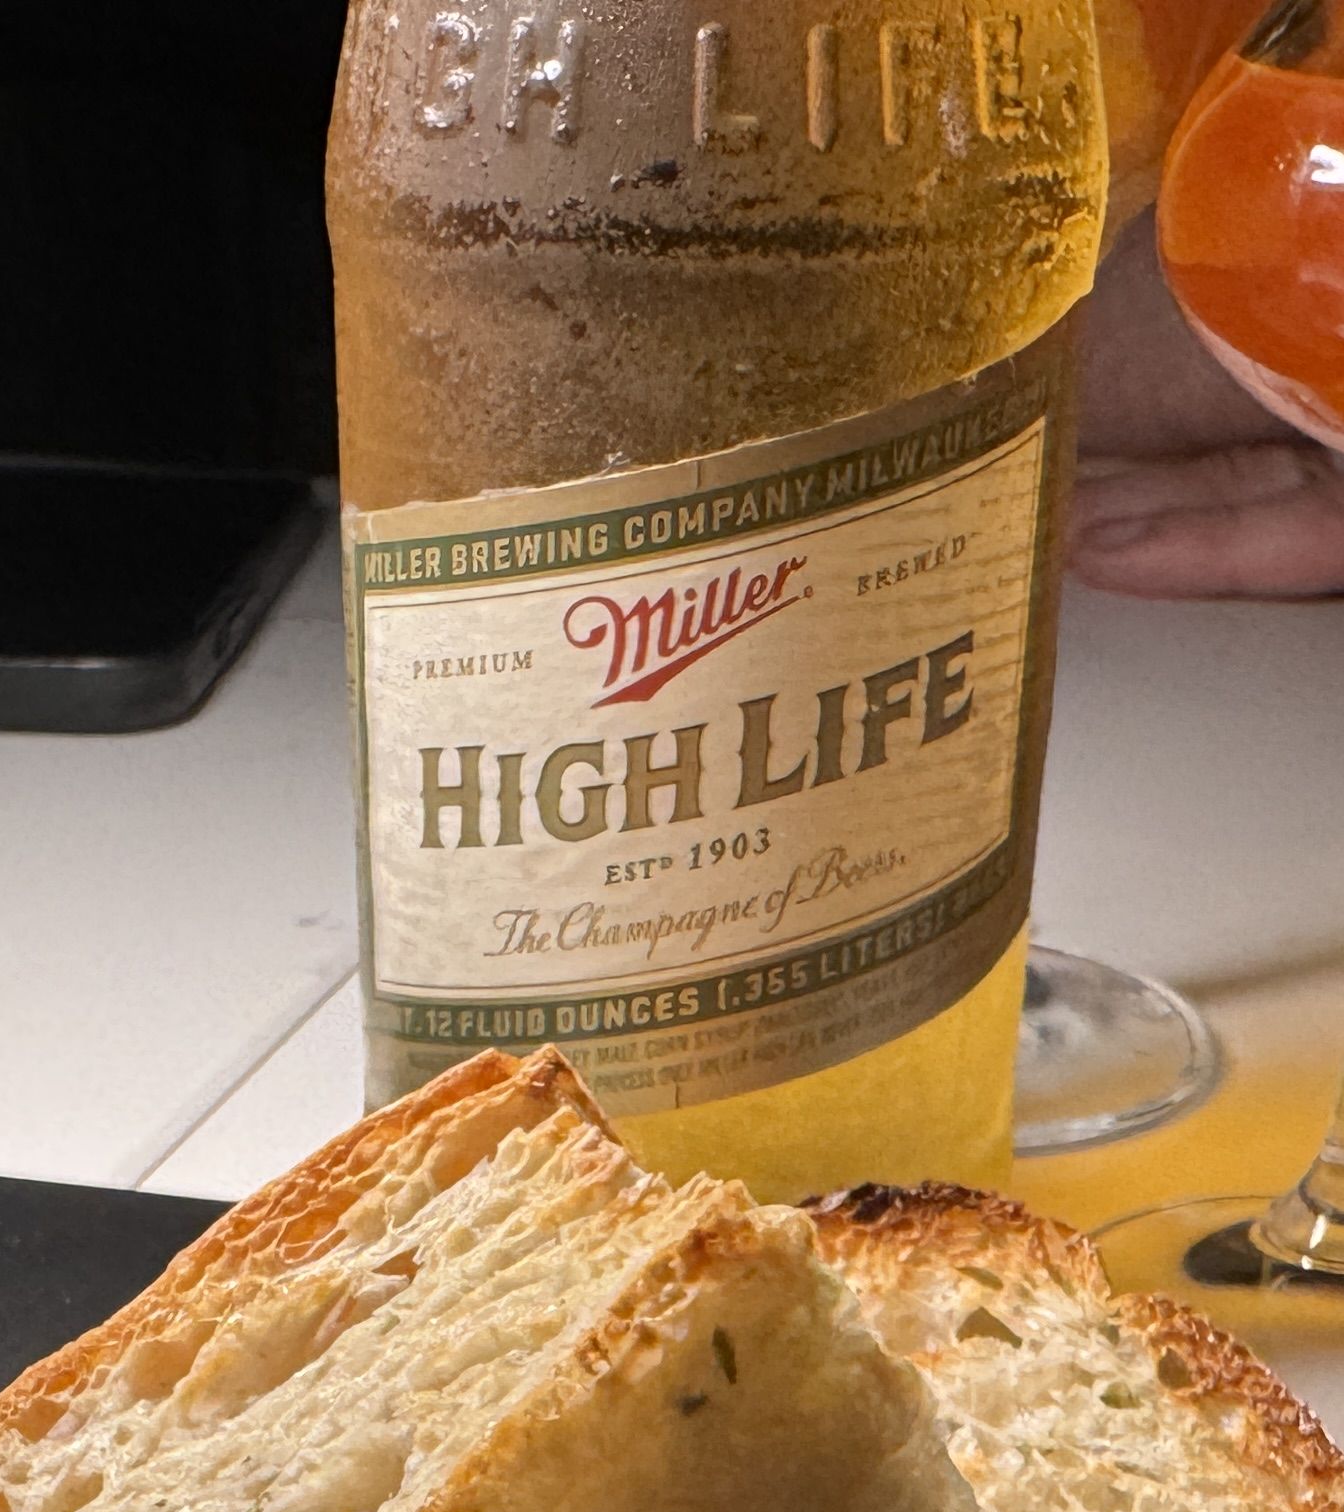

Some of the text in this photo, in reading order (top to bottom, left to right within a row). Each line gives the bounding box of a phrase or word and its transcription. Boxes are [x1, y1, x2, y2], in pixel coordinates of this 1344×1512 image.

[693, 14, 1028, 152] LIFE
[364, 546, 441, 583] MILLER
[451, 523, 609, 576] BREWING
[623, 473, 815, 550] COMPANY
[856, 533, 968, 597] BREWED
[412, 649, 535, 680] PREMIUM
[563, 555, 809, 690] Miller
[417, 630, 975, 850] HIGH LIFE
[687, 827, 772, 872] 1903
[482, 908, 551, 957] The
[555, 897, 758, 960] Champagne
[758, 867, 802, 934] of
[425, 1006, 453, 1038] 12
[457, 1006, 546, 1038] FLUID
[556, 986, 699, 1033] OUNCES
